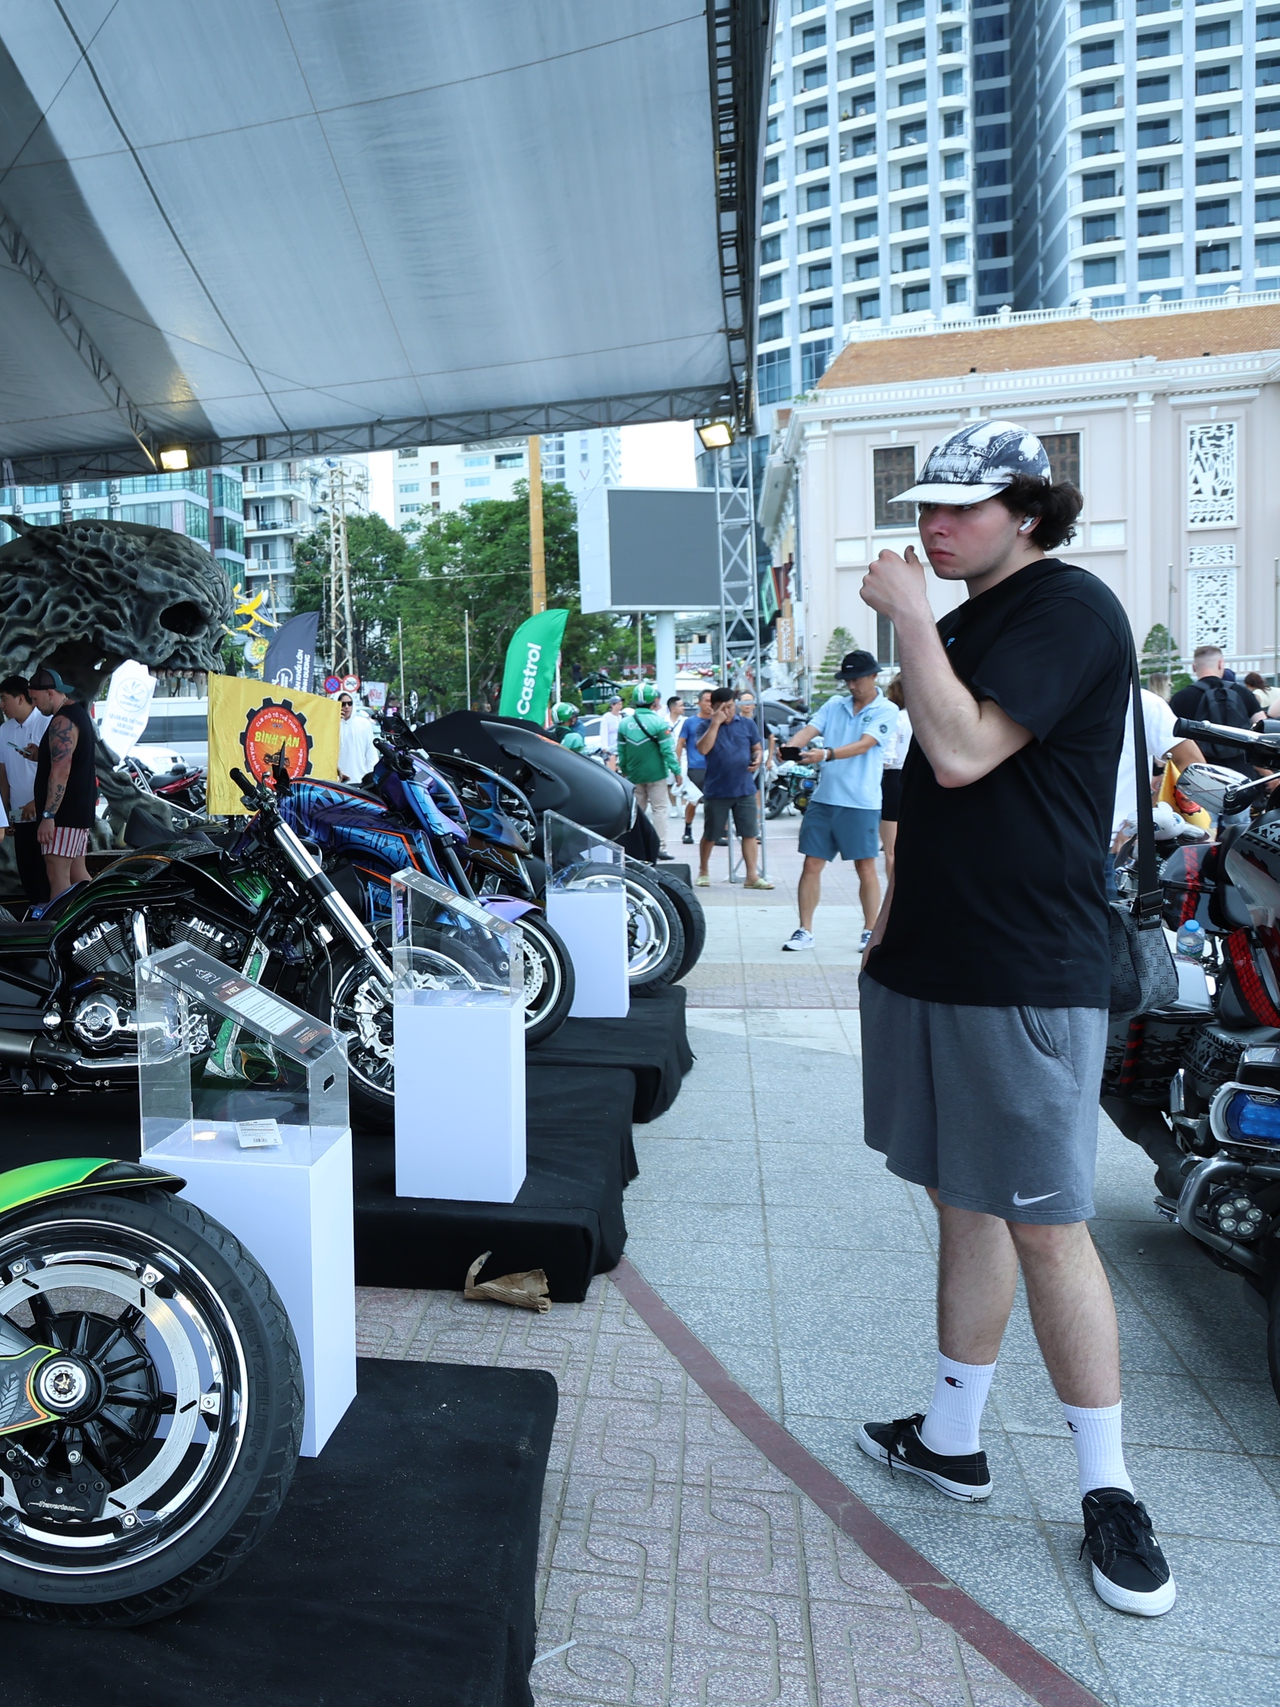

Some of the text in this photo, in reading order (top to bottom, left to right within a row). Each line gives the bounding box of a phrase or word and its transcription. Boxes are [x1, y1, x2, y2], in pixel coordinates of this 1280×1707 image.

[780, 618, 791, 660] COFFEE
[516, 642, 542, 715] Castrol
[255, 731, 300, 748] BÌNH TÂN
[256, 718, 265, 727] CLB
[238, 1306, 270, 1449] METZELER
